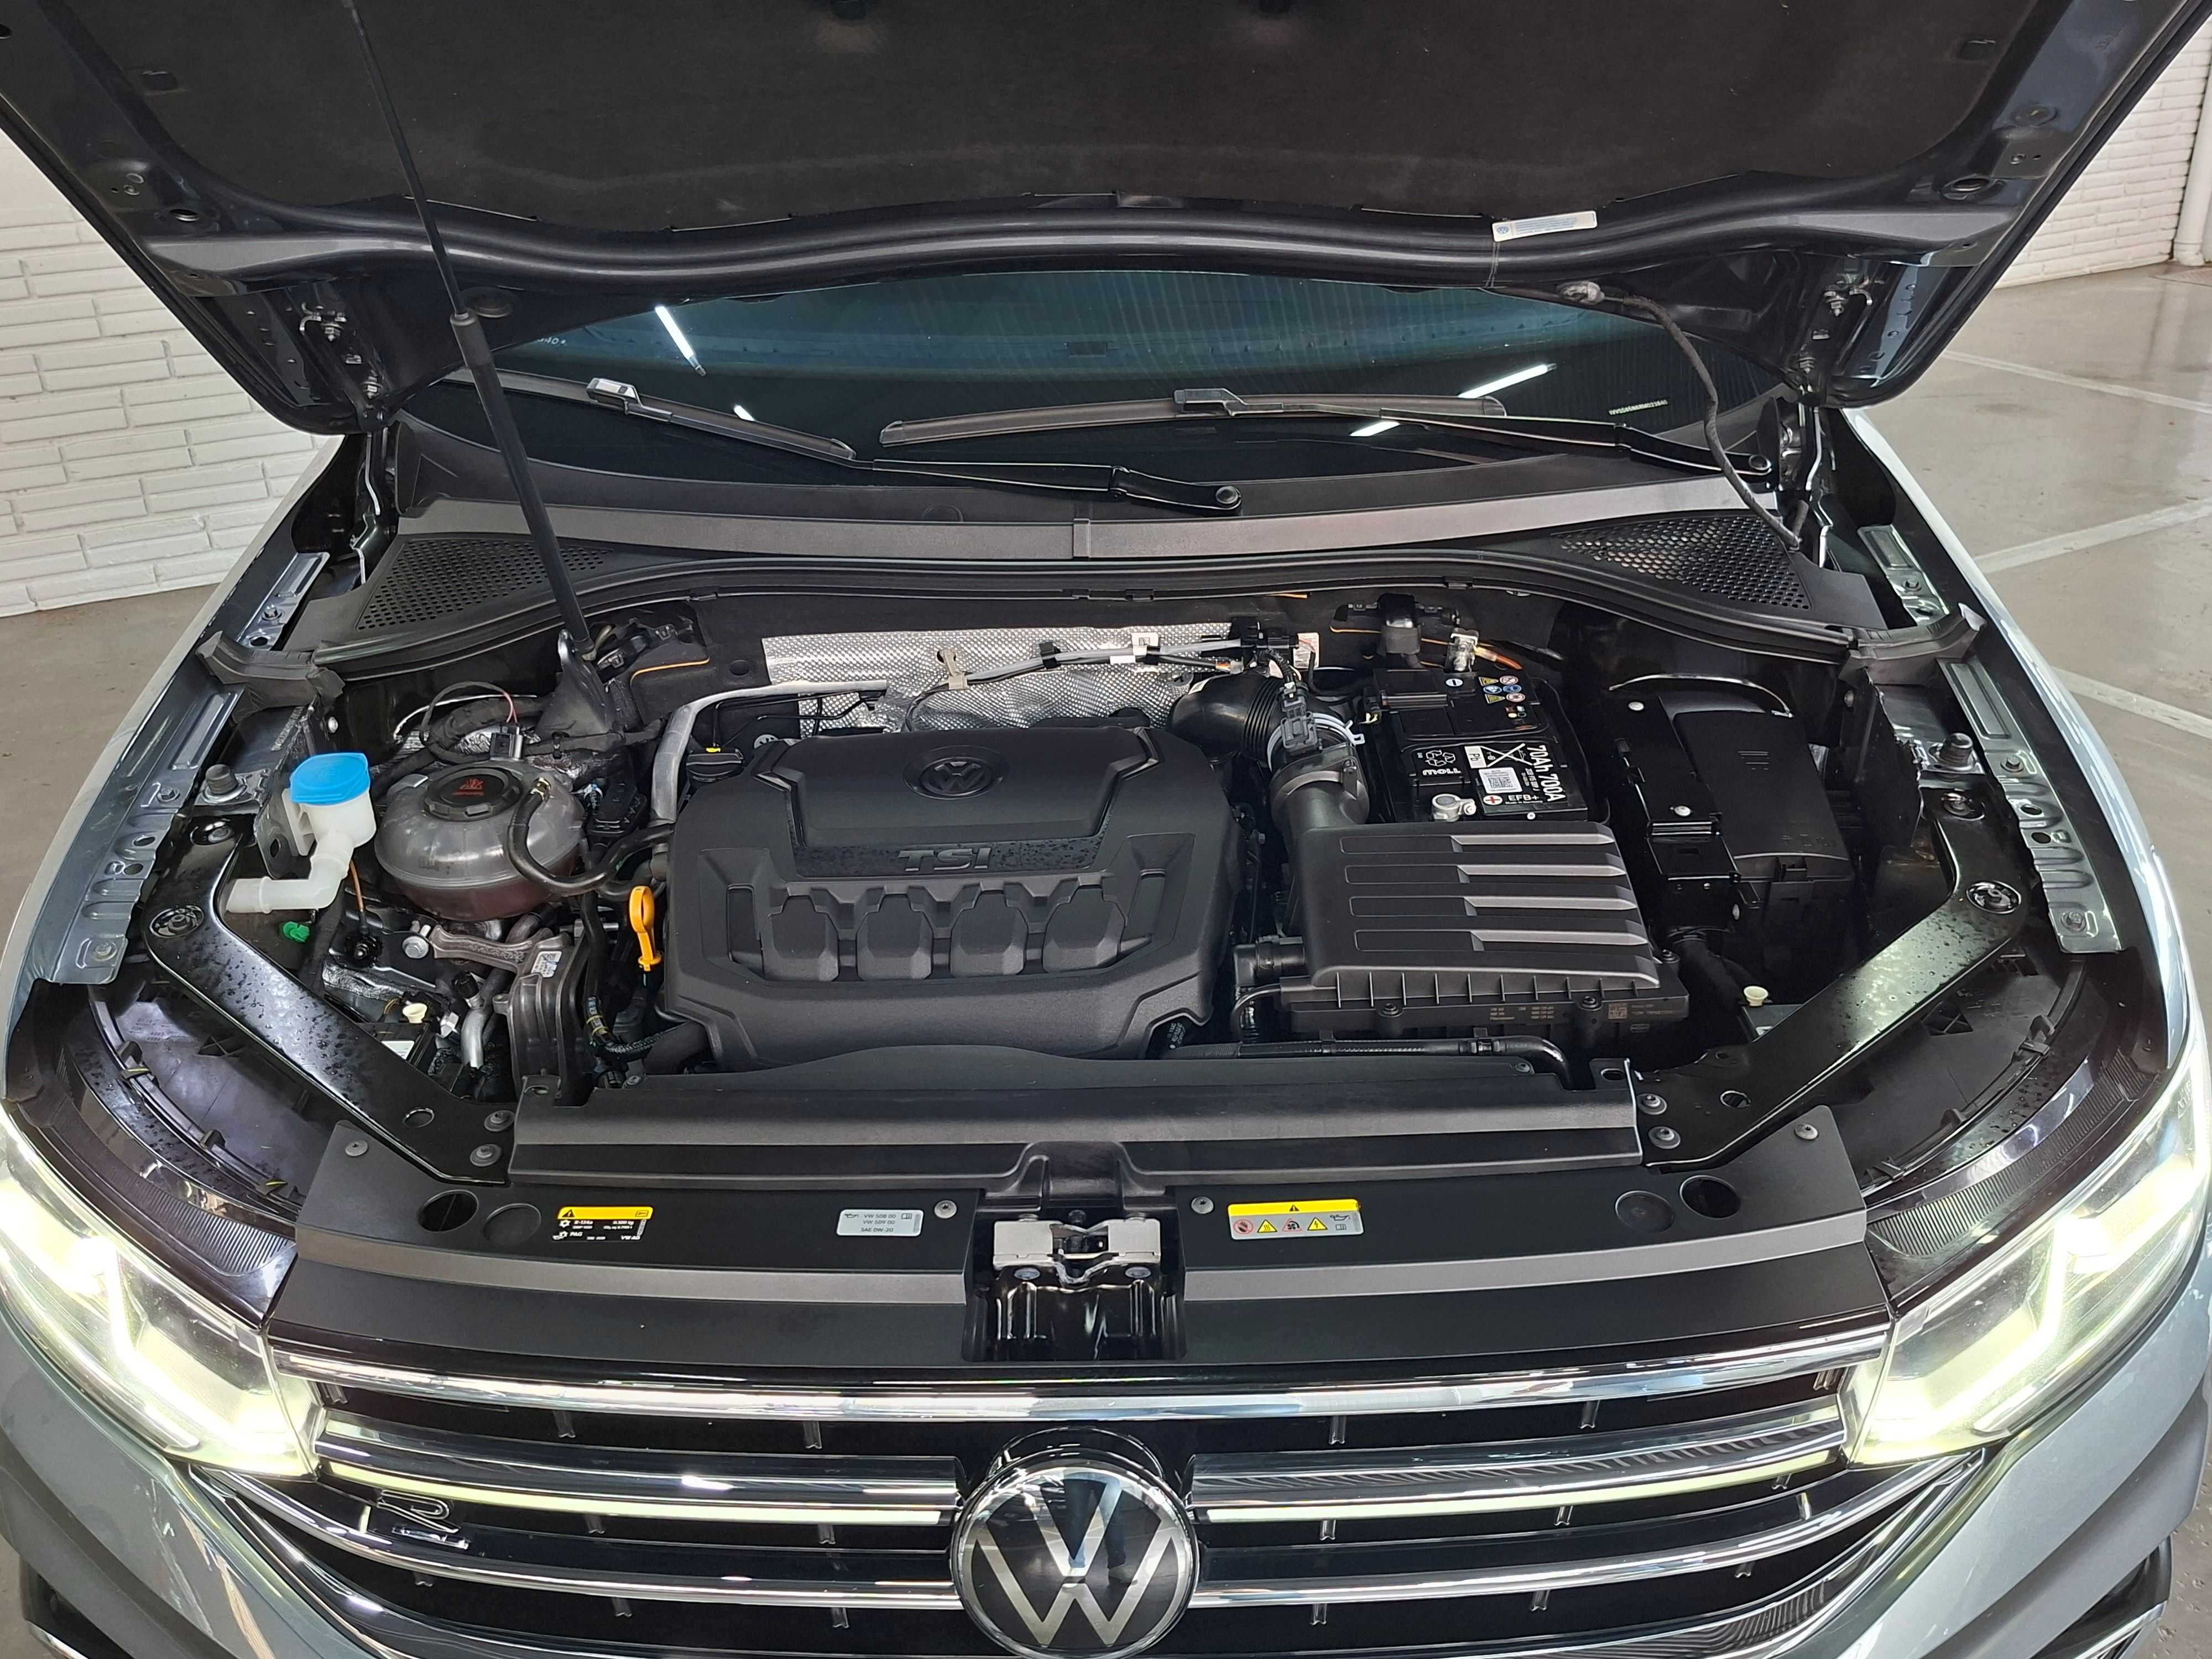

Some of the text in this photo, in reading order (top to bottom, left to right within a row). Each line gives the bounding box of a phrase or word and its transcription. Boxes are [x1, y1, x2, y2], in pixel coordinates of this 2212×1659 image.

[1468, 753, 1480, 761] Pb
[1527, 744, 1553, 773] 70Ah
[1538, 773, 1566, 802] 700A
[898, 847, 993, 872] TSI
